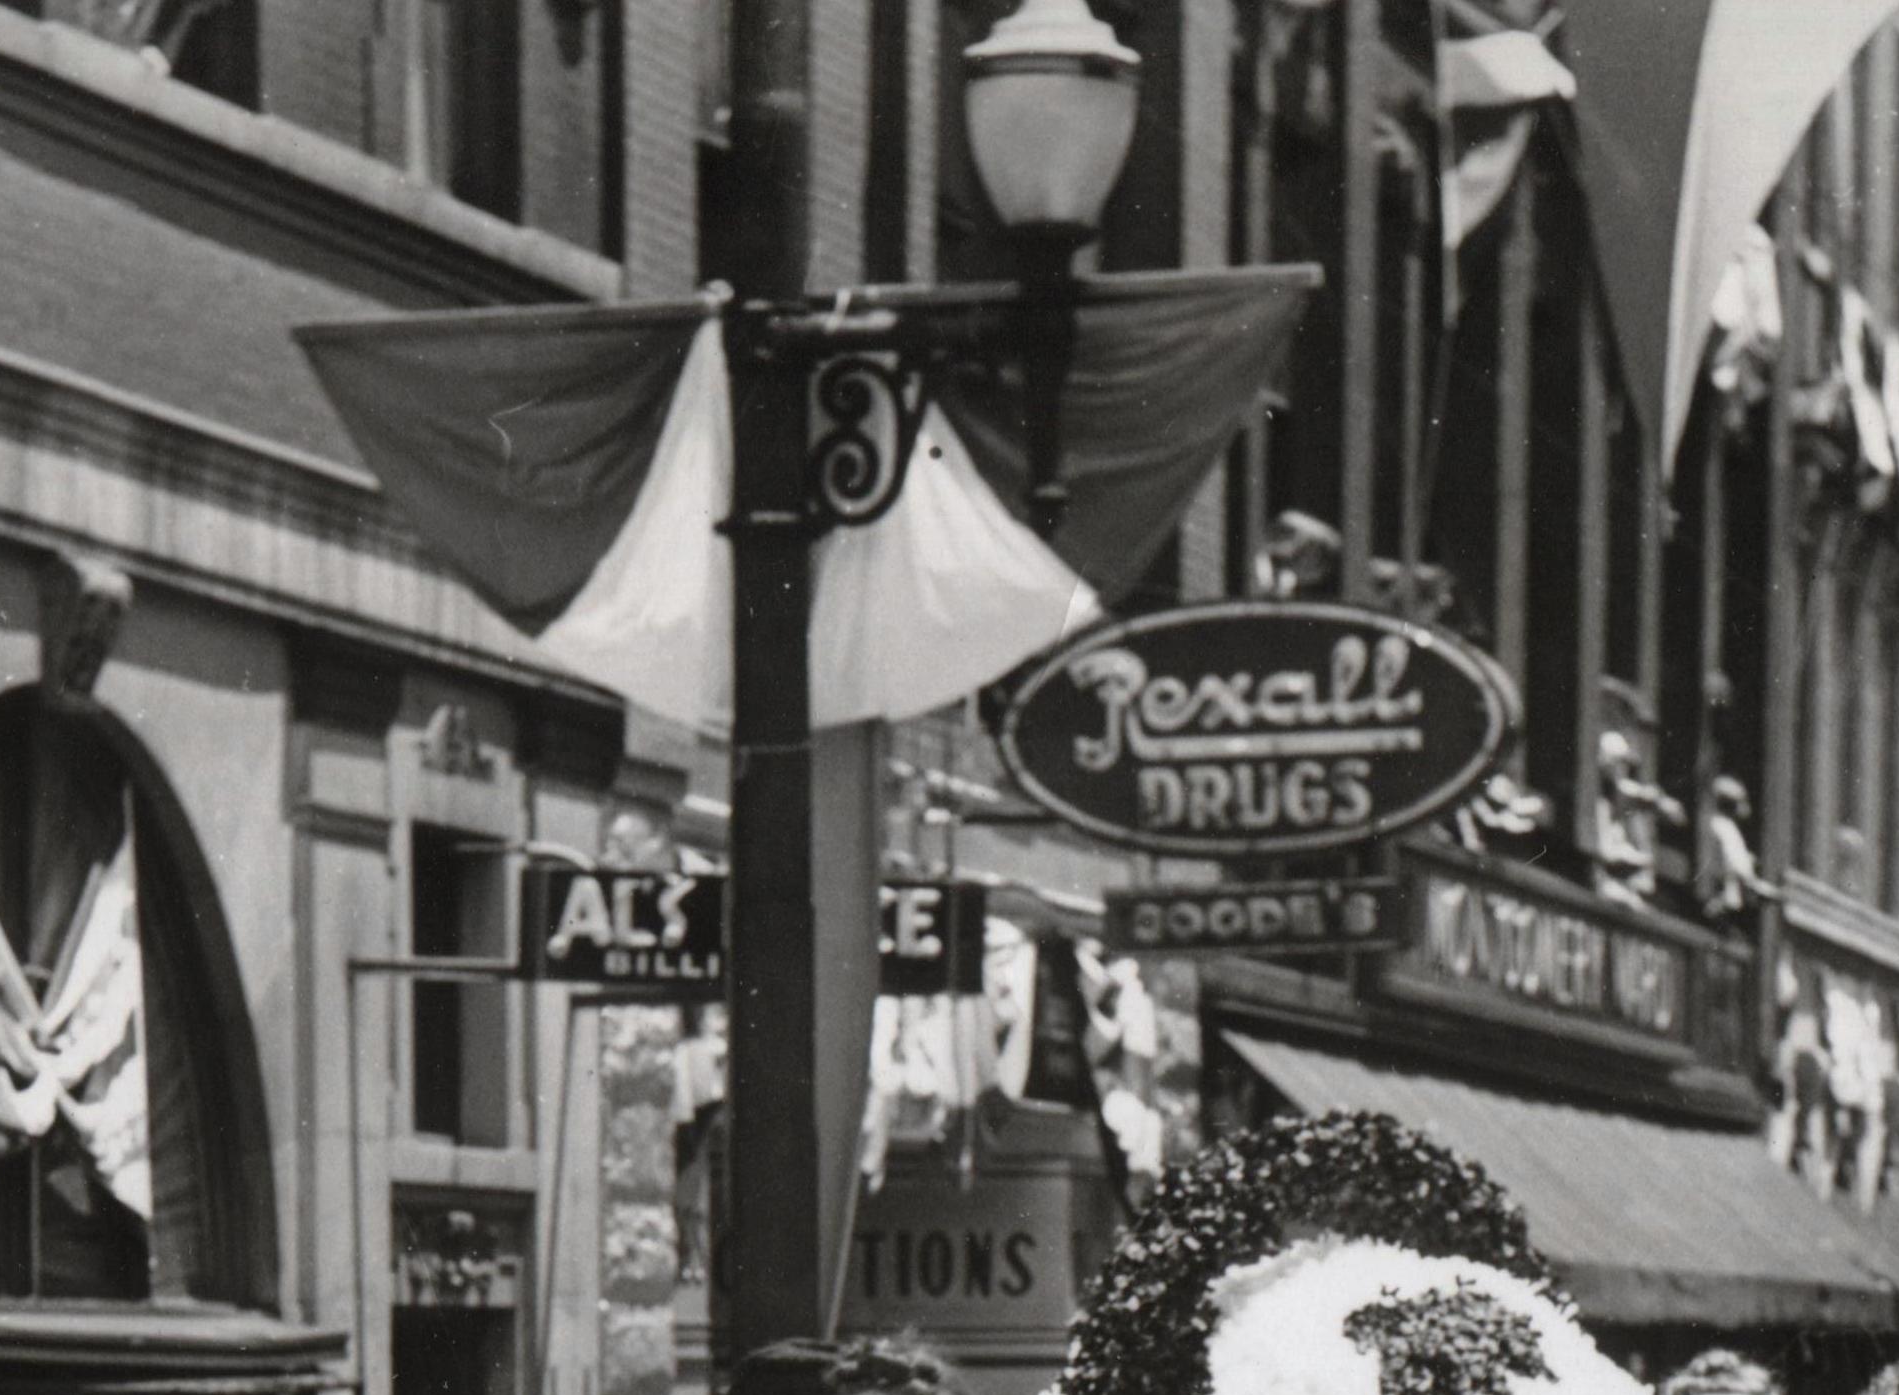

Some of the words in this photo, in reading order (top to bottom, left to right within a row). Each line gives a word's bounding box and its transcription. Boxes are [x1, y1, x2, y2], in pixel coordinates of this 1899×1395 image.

[1066, 632, 1423, 772] Rexall
[1137, 757, 1374, 830] DRUGS
[546, 873, 697, 958] AL'S
[1133, 878, 1377, 943] GOODE'S
[604, 951, 721, 979] BILLI
